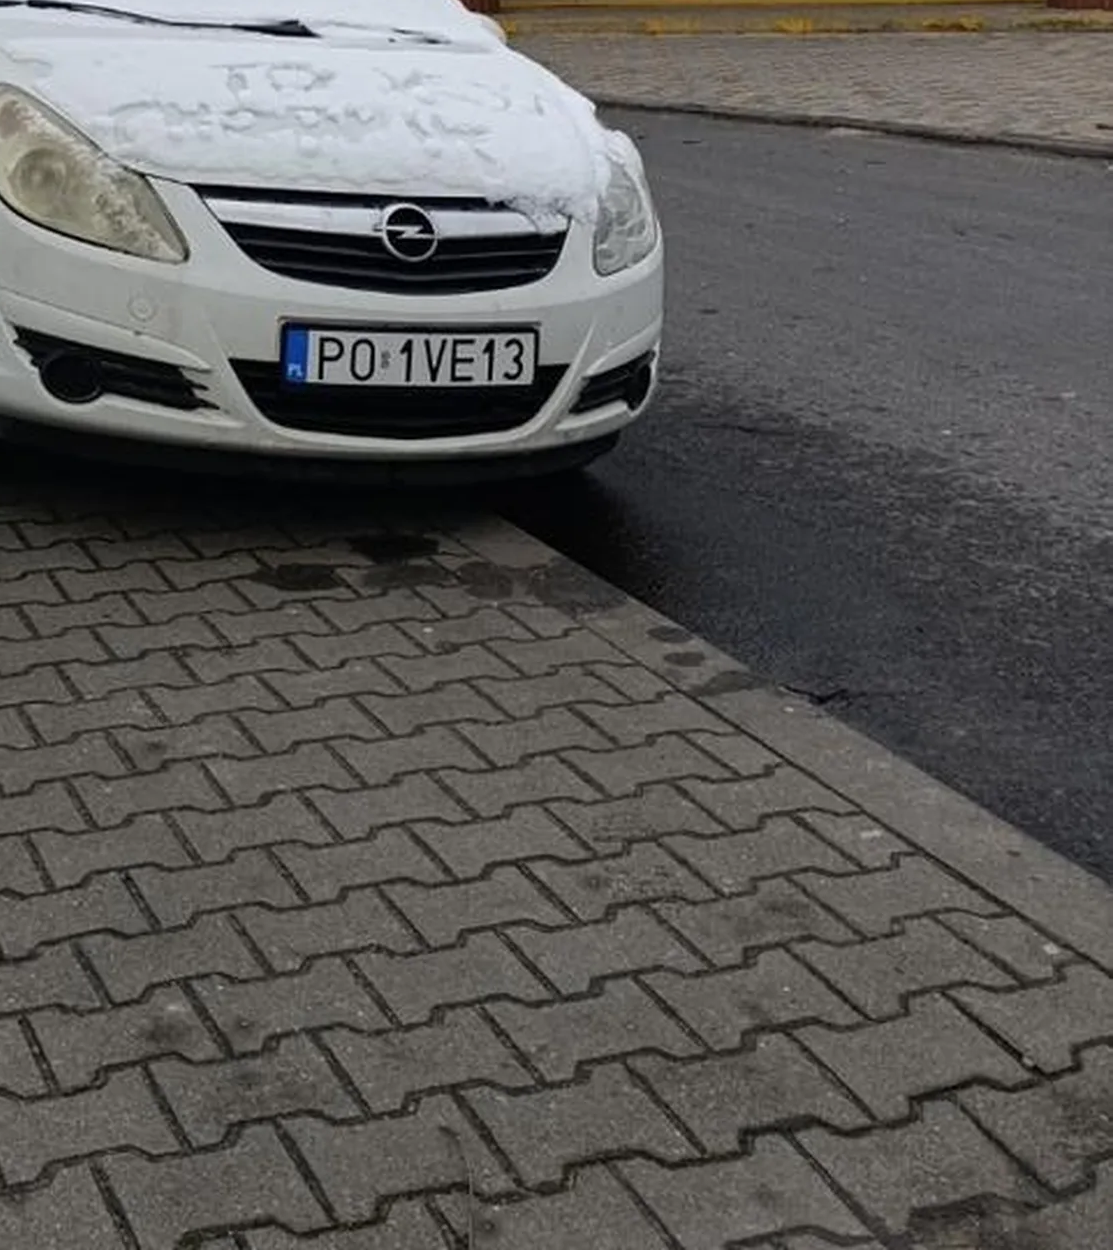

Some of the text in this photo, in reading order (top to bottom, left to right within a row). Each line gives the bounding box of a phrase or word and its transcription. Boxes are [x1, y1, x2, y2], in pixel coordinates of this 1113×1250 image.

[288, 363, 304, 377] PL
[318, 336, 524, 383] PO 1VE13
